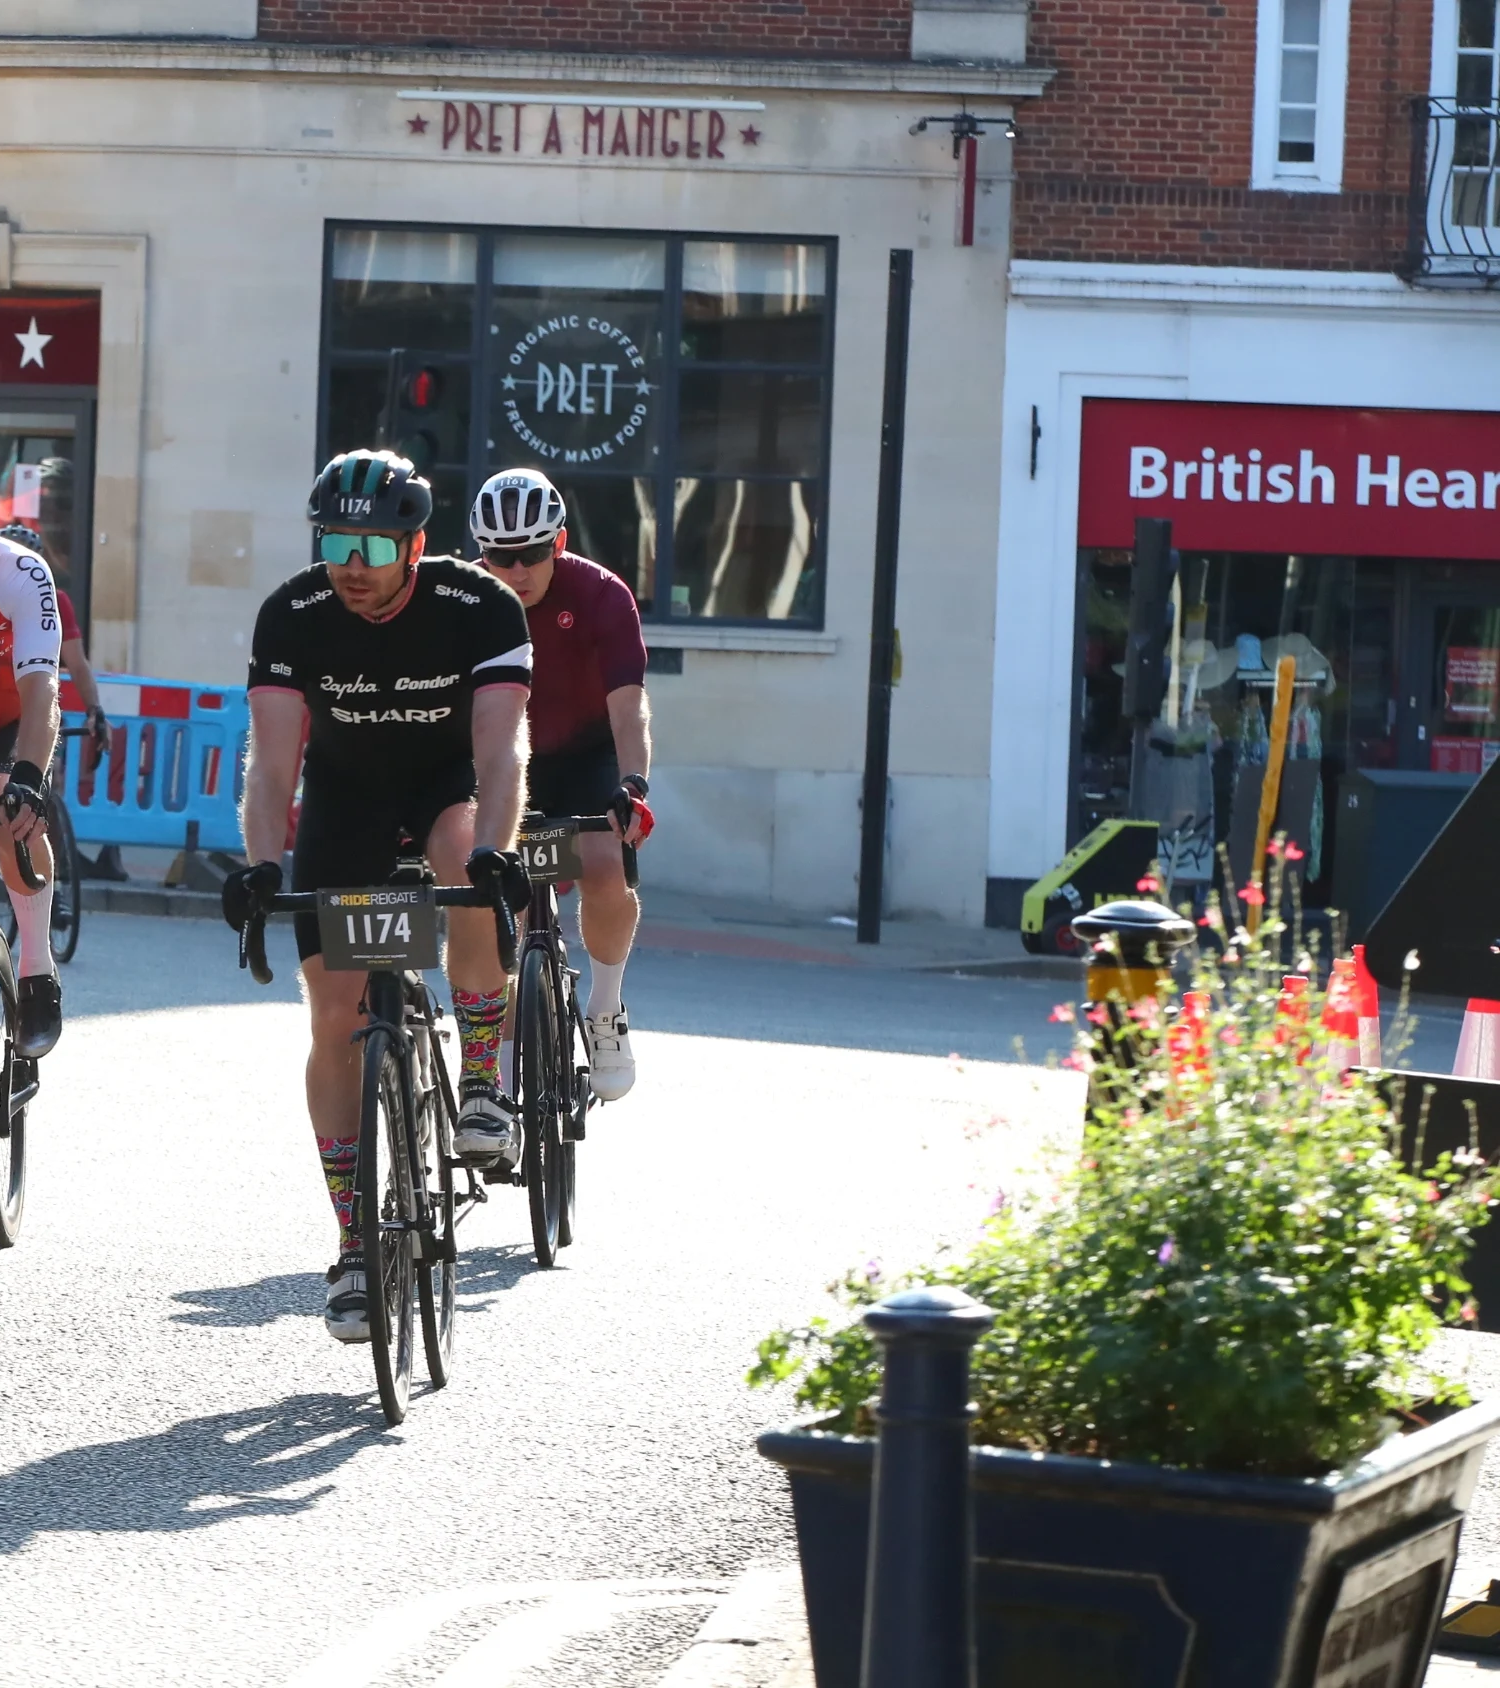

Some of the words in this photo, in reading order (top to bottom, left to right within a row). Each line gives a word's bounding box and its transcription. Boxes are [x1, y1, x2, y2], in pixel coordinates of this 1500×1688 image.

[442, 101, 527, 152] PRET
[543, 104, 561, 154] A
[583, 105, 725, 159] MANGER
[509, 315, 580, 366] ORGANIC
[587, 316, 645, 369] COFFEE
[536, 361, 619, 415] PRET
[503, 399, 560, 459] FRESHLY
[564, 441, 614, 463] MADE
[615, 403, 648, 446] FOOD
[500, 478, 525, 487] 1161
[1129, 445, 1336, 505] British
[1356, 453, 1500, 510] Hear
[340, 498, 372, 515] 1174
[16, 555, 58, 631] Cofidis
[291, 589, 334, 610] SHARP
[434, 584, 481, 605] SHARP
[320, 673, 378, 700] Rapha
[394, 674, 460, 691] Condor
[330, 706, 452, 724] SHARP
[518, 827, 566, 842] EREIGATE
[522, 843, 559, 868] 161
[345, 911, 412, 944] 1174
